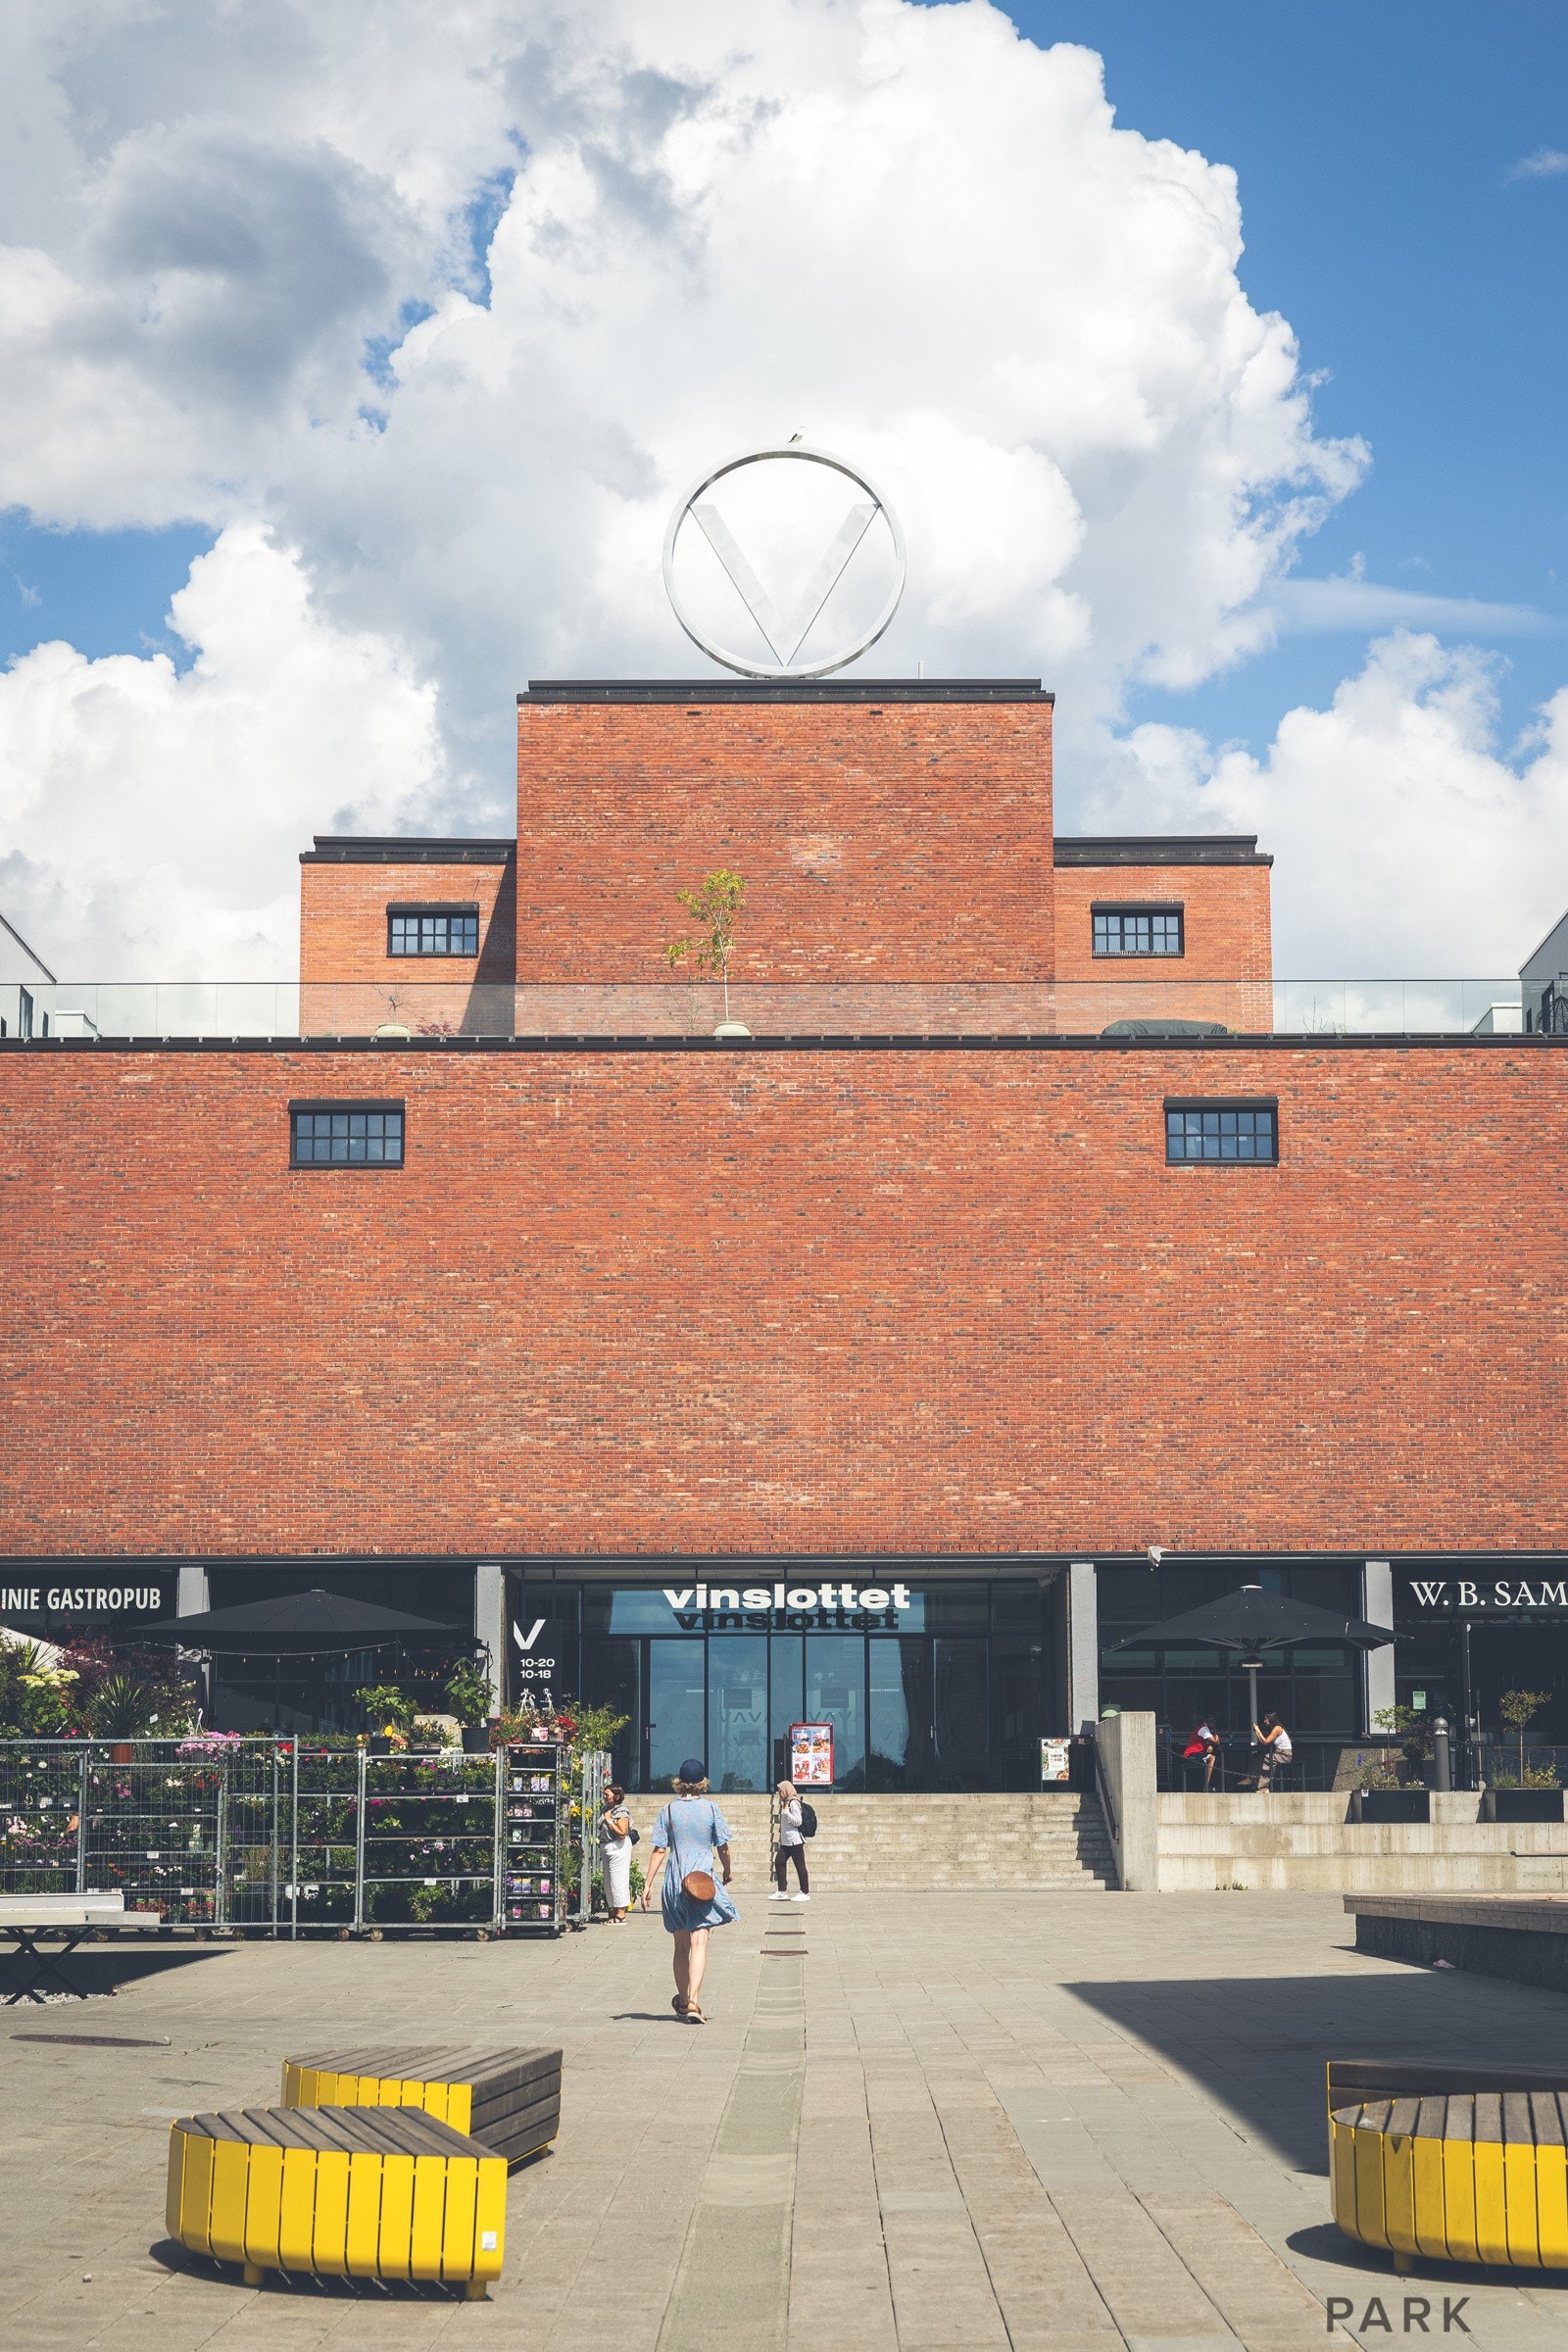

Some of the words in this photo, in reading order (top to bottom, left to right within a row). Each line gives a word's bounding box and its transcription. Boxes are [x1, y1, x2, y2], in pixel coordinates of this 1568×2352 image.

[47, 1588, 162, 1610] GASTROPUB
[662, 1583, 910, 1609] vinslottet
[1409, 1581, 1449, 1607] W.
[1457, 1581, 1487, 1606] B.
[1494, 1581, 1568, 1607] SAM
[513, 1618, 547, 1650] V
[519, 1658, 556, 1668] 10-20
[519, 1669, 552, 1679] 10-18
